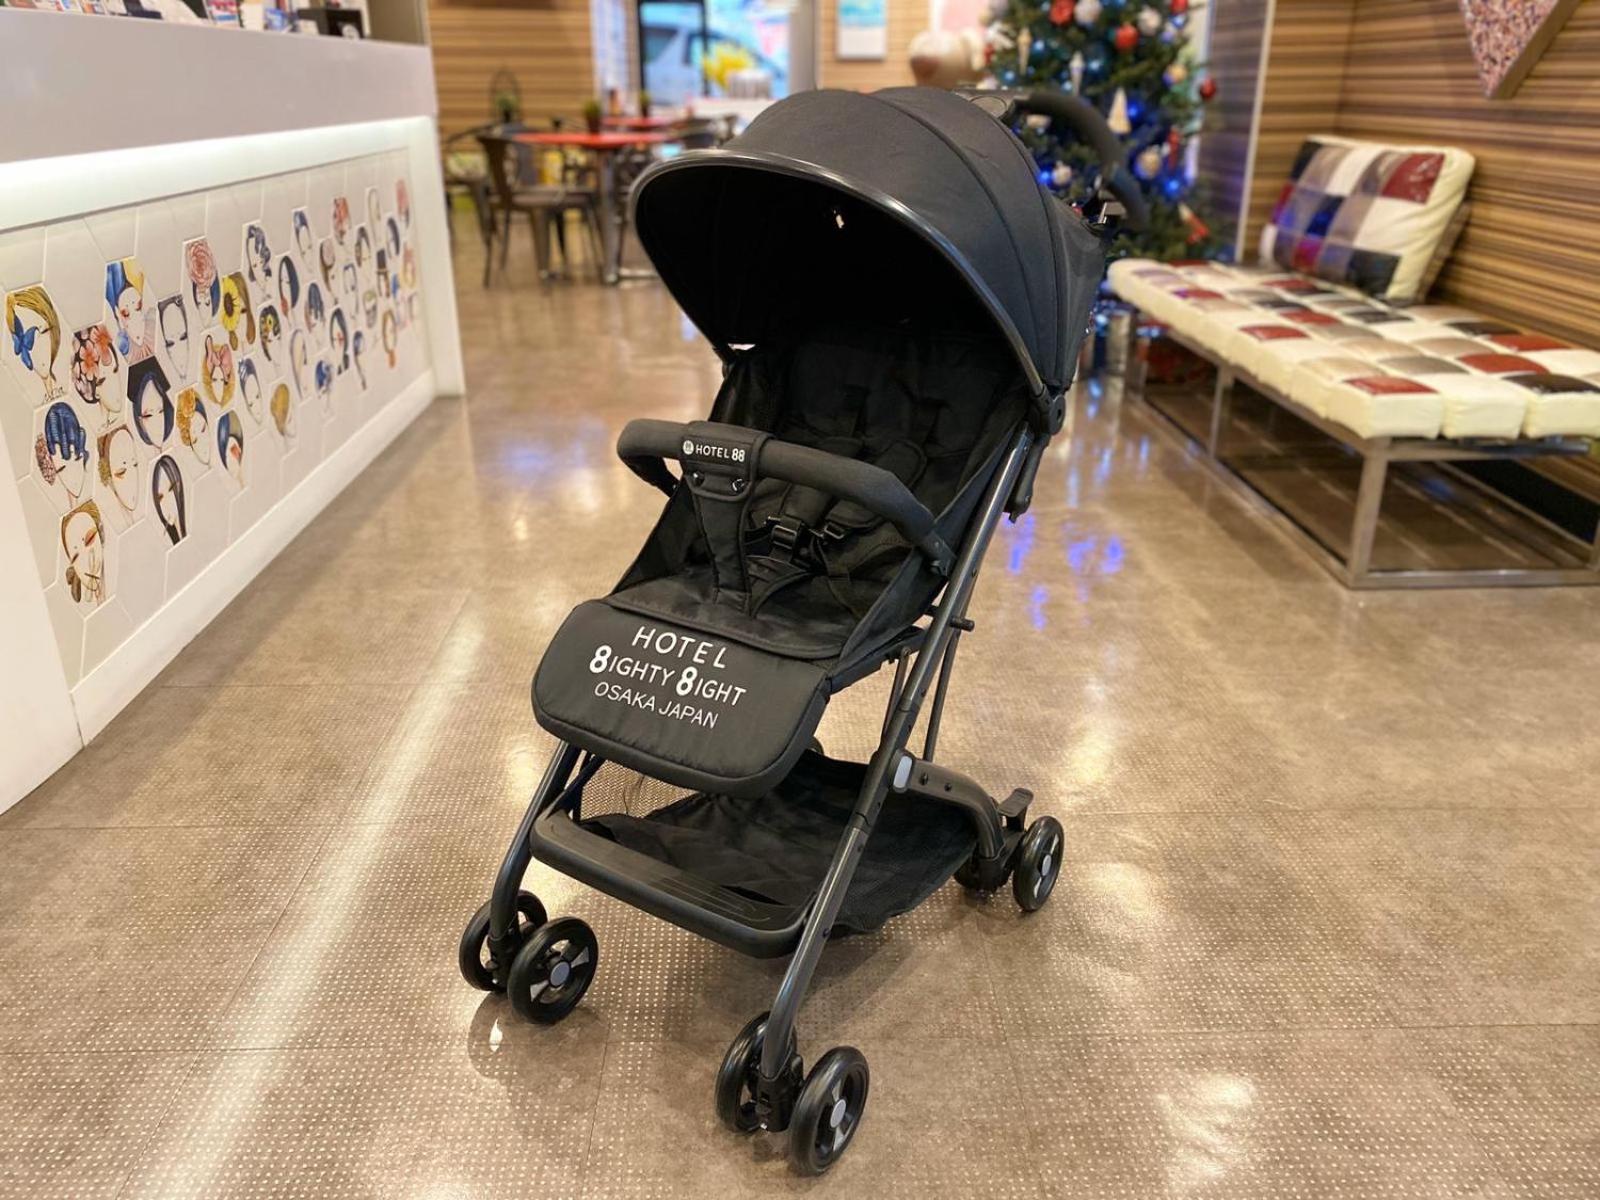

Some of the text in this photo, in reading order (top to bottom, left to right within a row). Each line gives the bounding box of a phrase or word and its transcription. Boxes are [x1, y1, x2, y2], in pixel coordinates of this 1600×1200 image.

[695, 444, 730, 459] HOTEL
[731, 448, 746, 462] 88
[631, 626, 727, 669] HOTEL
[589, 645, 747, 706] 8IGHTY 8IGHT
[594, 682, 719, 729] OSAKA JAPAN
